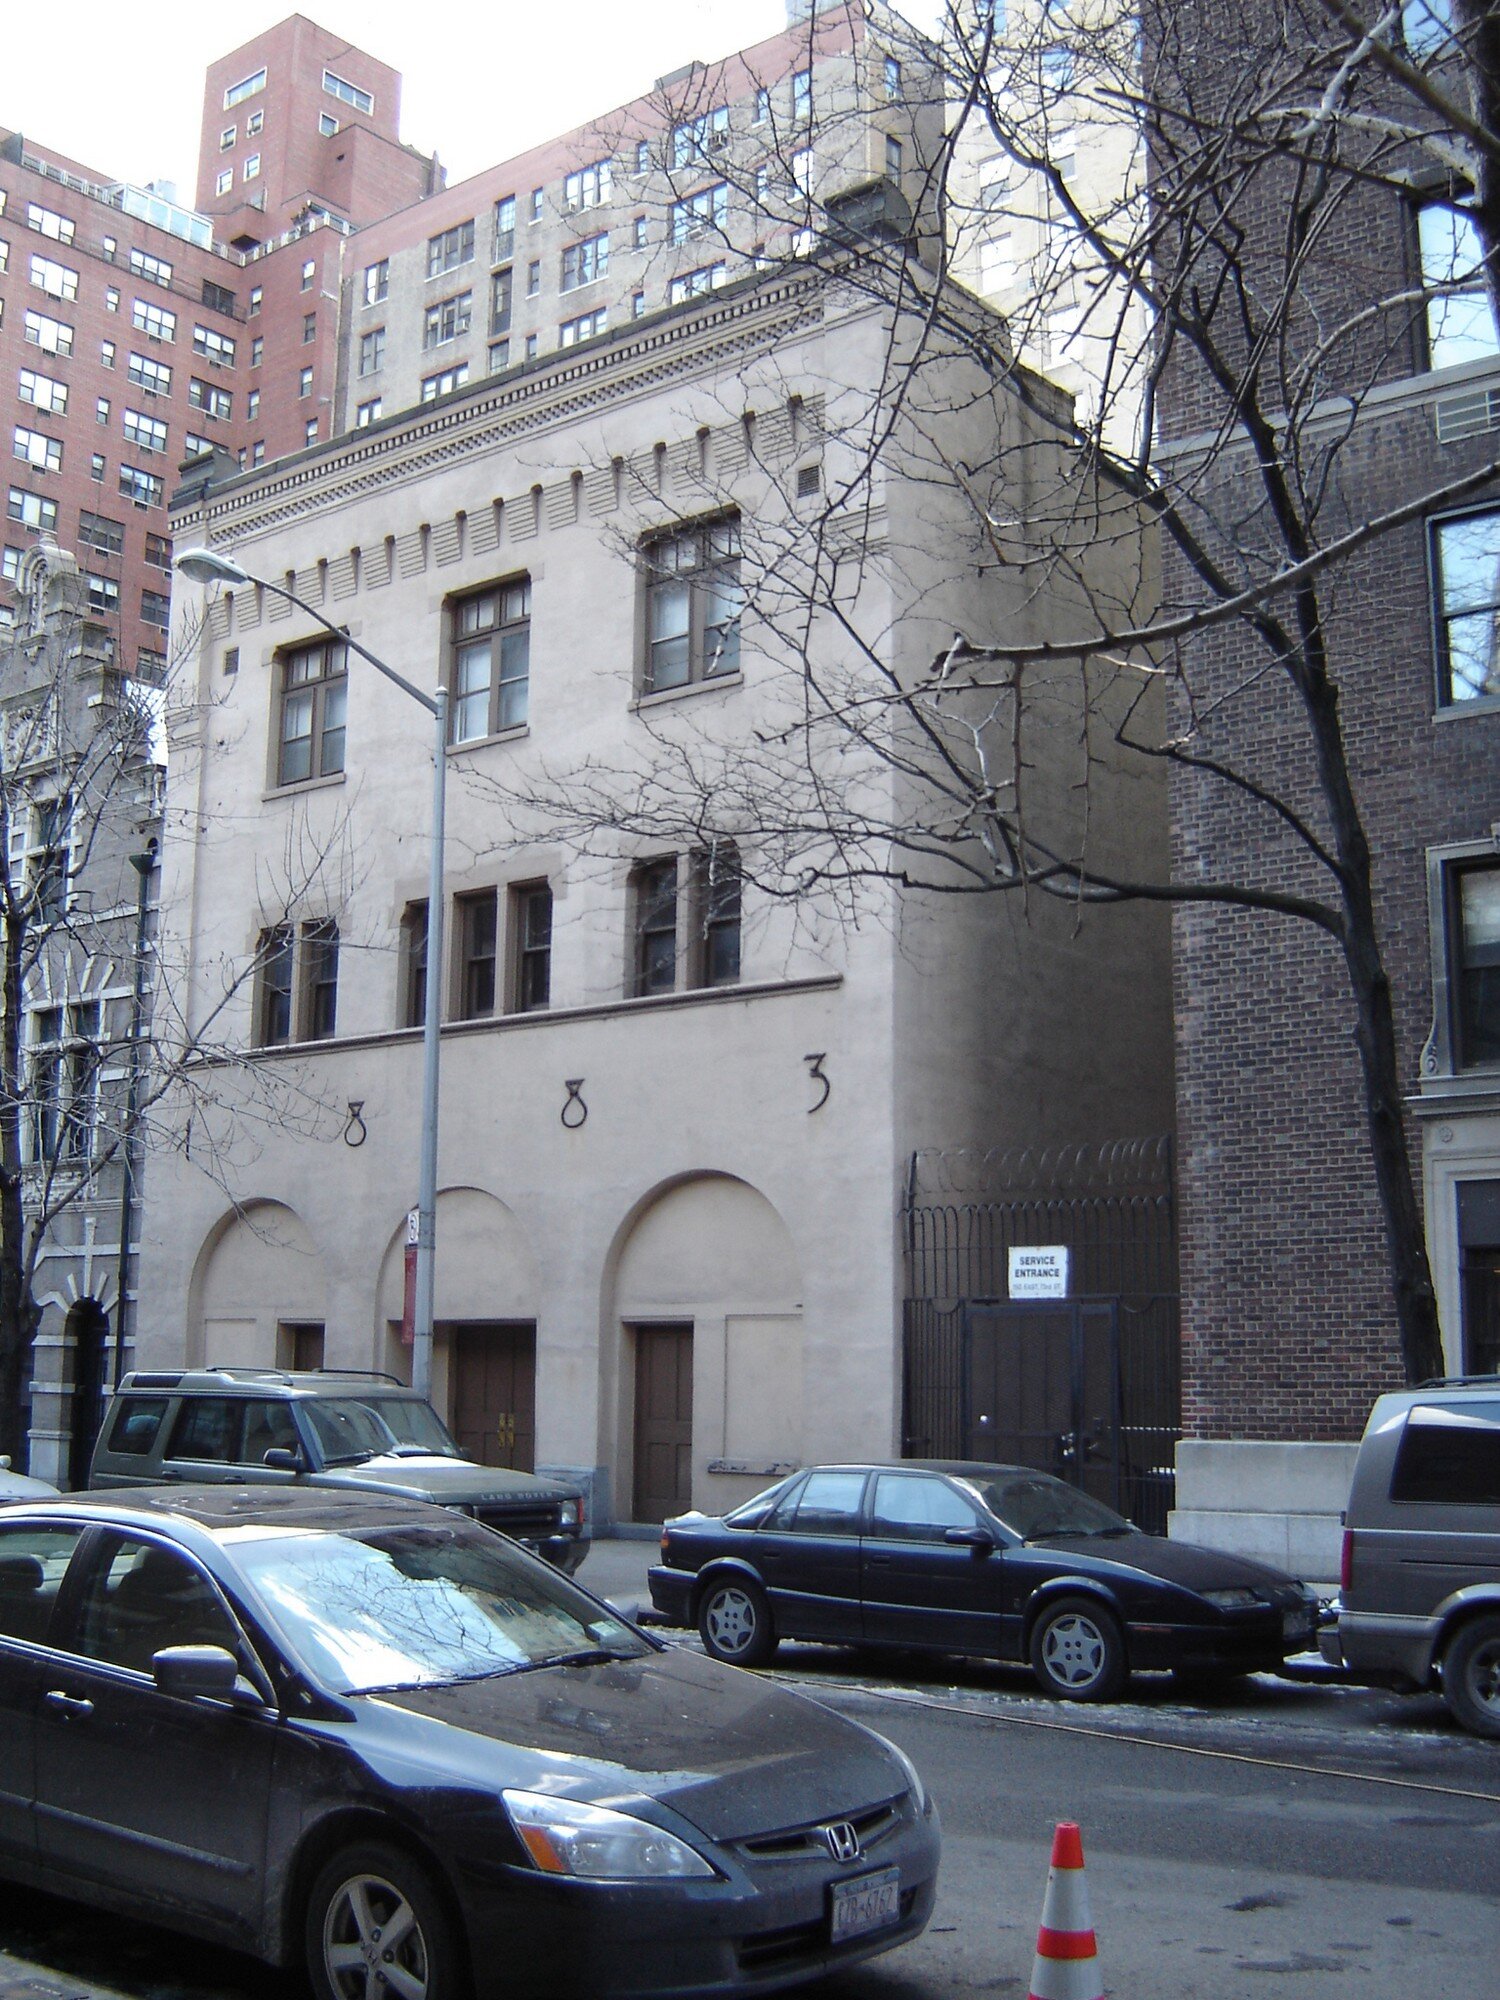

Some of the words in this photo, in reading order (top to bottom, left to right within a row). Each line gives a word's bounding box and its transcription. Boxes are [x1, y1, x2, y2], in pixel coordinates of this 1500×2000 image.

[1019, 1256, 1055, 1266] SERVICE
[1014, 1268, 1060, 1278] ENTRANCE
[481, 1493, 512, 1501] LAND
[517, 1491, 553, 1500] ROVER
